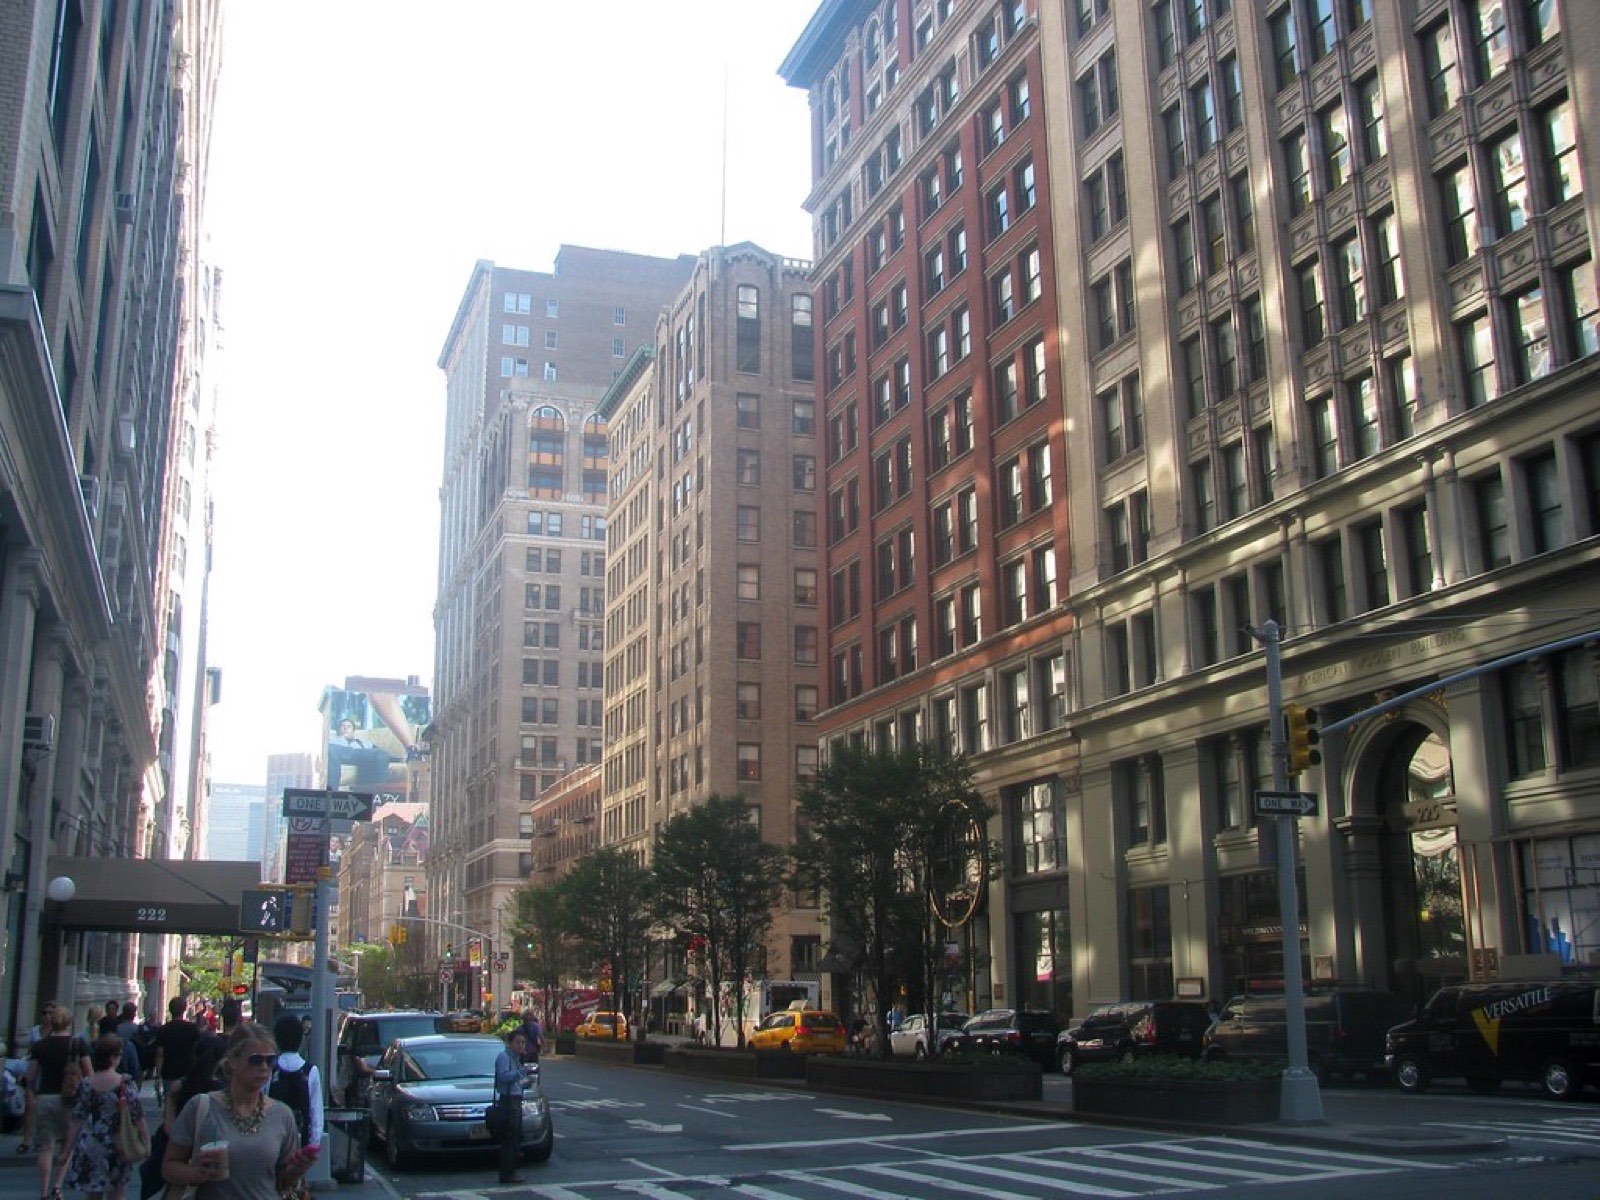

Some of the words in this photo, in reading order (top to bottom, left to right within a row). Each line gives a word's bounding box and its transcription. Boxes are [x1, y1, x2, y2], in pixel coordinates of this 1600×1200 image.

[296, 798, 321, 810] ONE
[332, 799, 358, 812] WAY
[1264, 797, 1284, 809] ONE
[1290, 798, 1309, 810] WAY
[137, 908, 166, 921] 222
